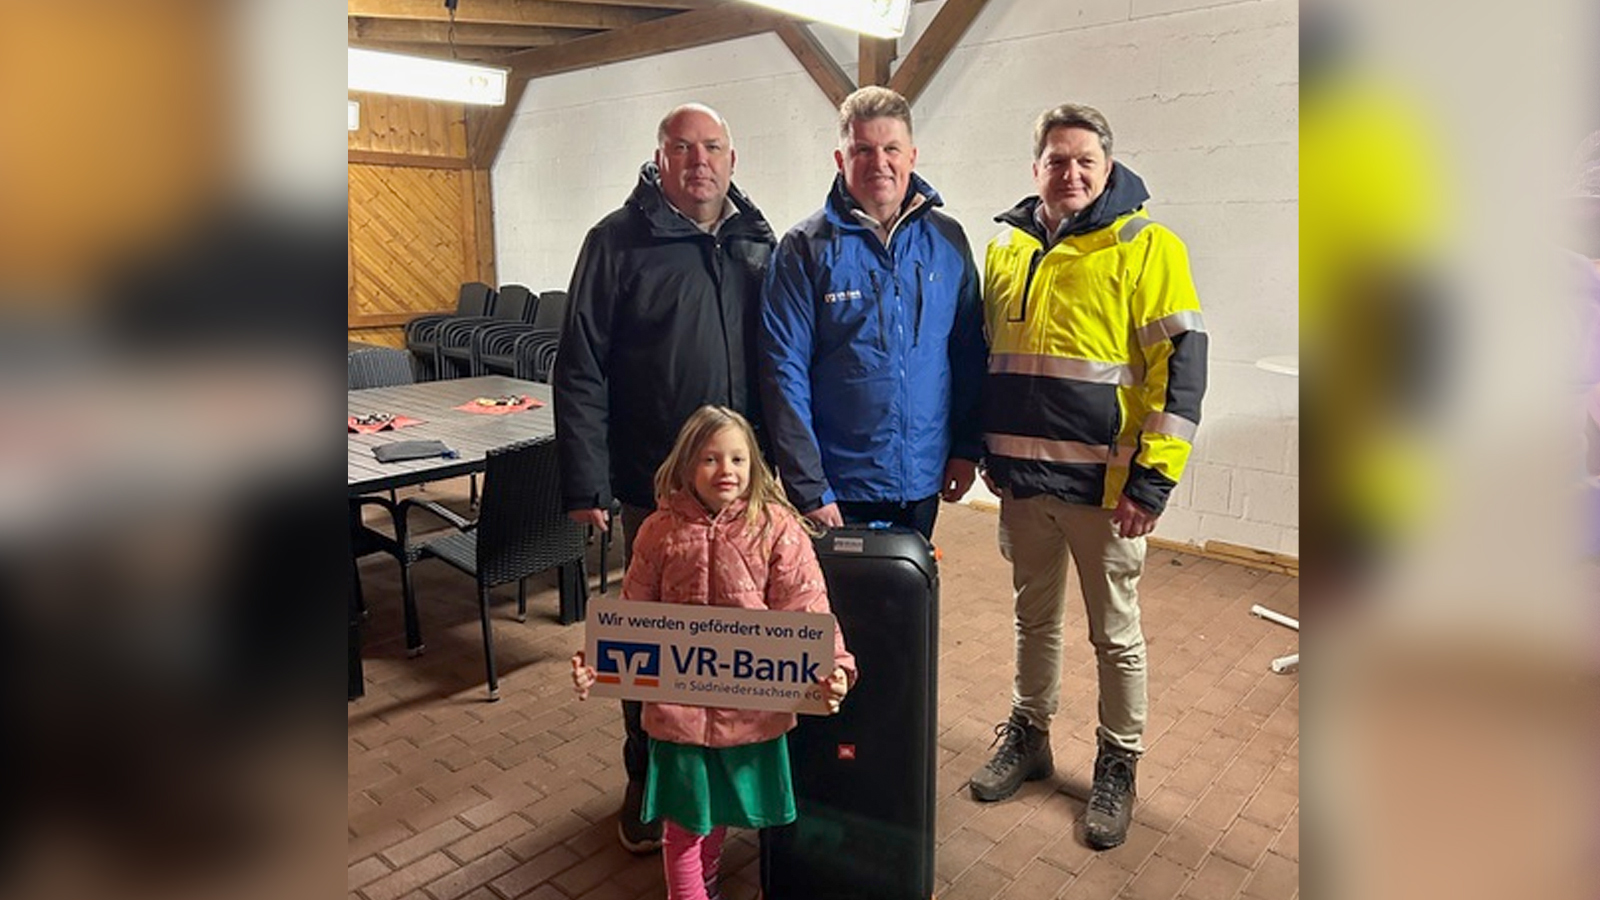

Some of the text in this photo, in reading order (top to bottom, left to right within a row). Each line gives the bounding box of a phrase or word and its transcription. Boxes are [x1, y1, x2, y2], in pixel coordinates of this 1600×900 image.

[598, 612, 823, 640] Wir werden gefördert von der
[670, 644, 820, 684] VR-Bank
[690, 681, 801, 699] Südniedersachsen
[805, 690, 822, 700] eG
